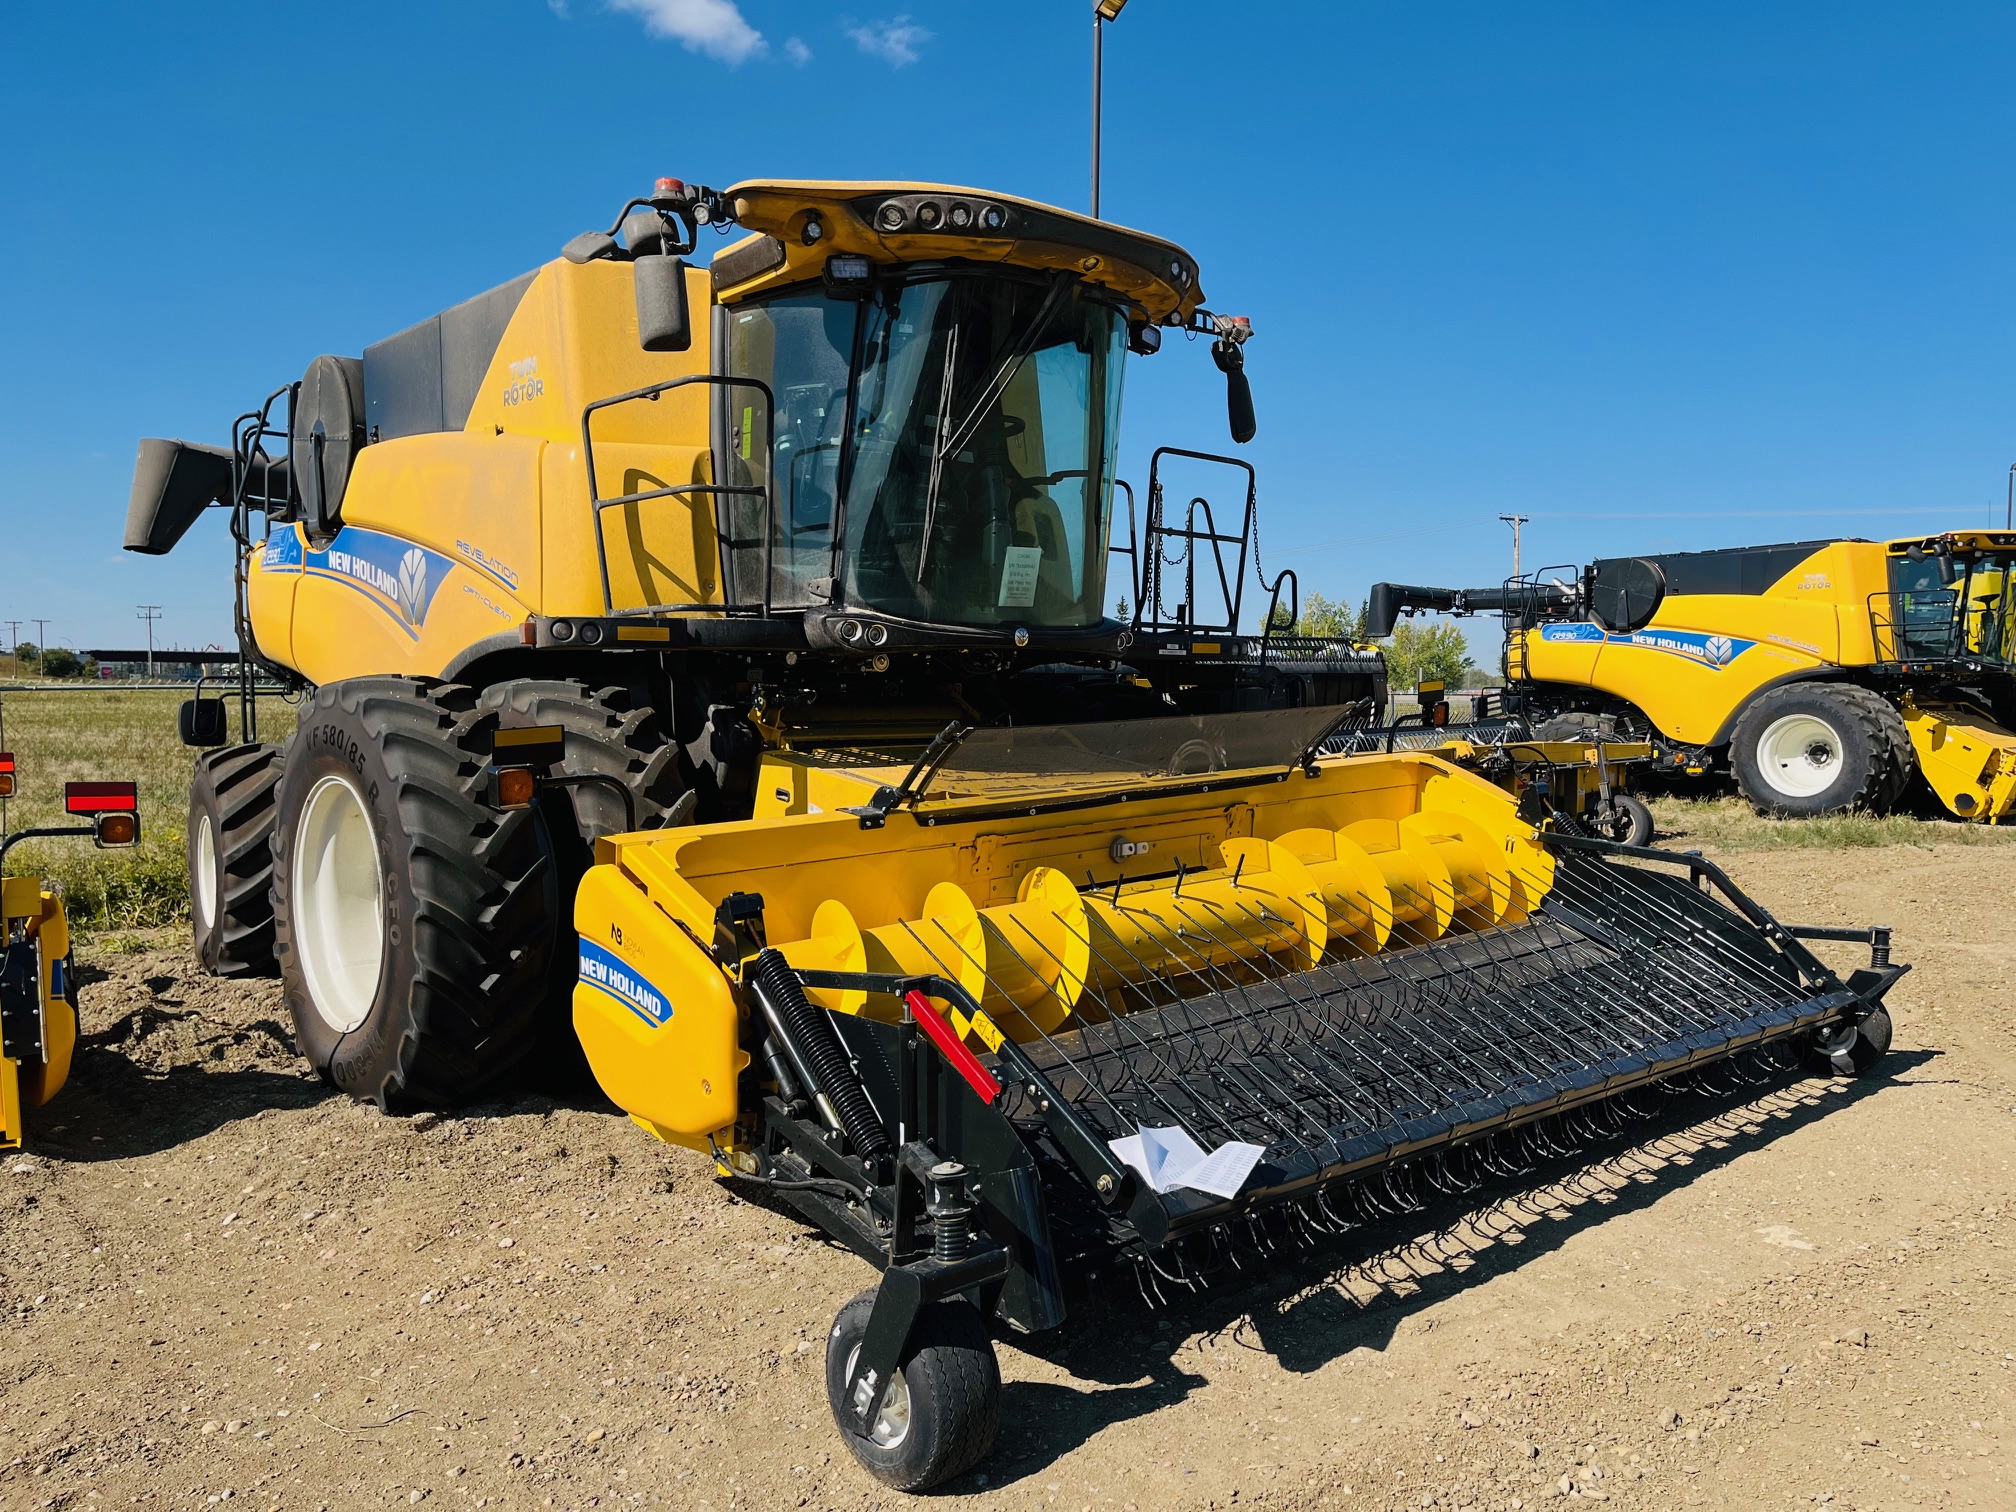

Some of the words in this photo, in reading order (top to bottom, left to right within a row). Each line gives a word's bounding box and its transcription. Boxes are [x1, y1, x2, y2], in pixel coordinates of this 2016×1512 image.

[503, 377, 544, 407] ROTOR
[328, 550, 350, 573] NEW
[352, 556, 399, 601] HOLLAND
[455, 539, 520, 585] REVELATION
[462, 584, 513, 623] OPTI-CLEAN
[1797, 581, 1831, 590] ROTOR
[1632, 634, 1656, 646] NEW
[1657, 637, 1705, 657] HOLLAND
[305, 725, 320, 752] VF
[322, 724, 367, 775] 580/85
[580, 956, 608, 982] NEW
[608, 967, 662, 1017] HOLLAND
